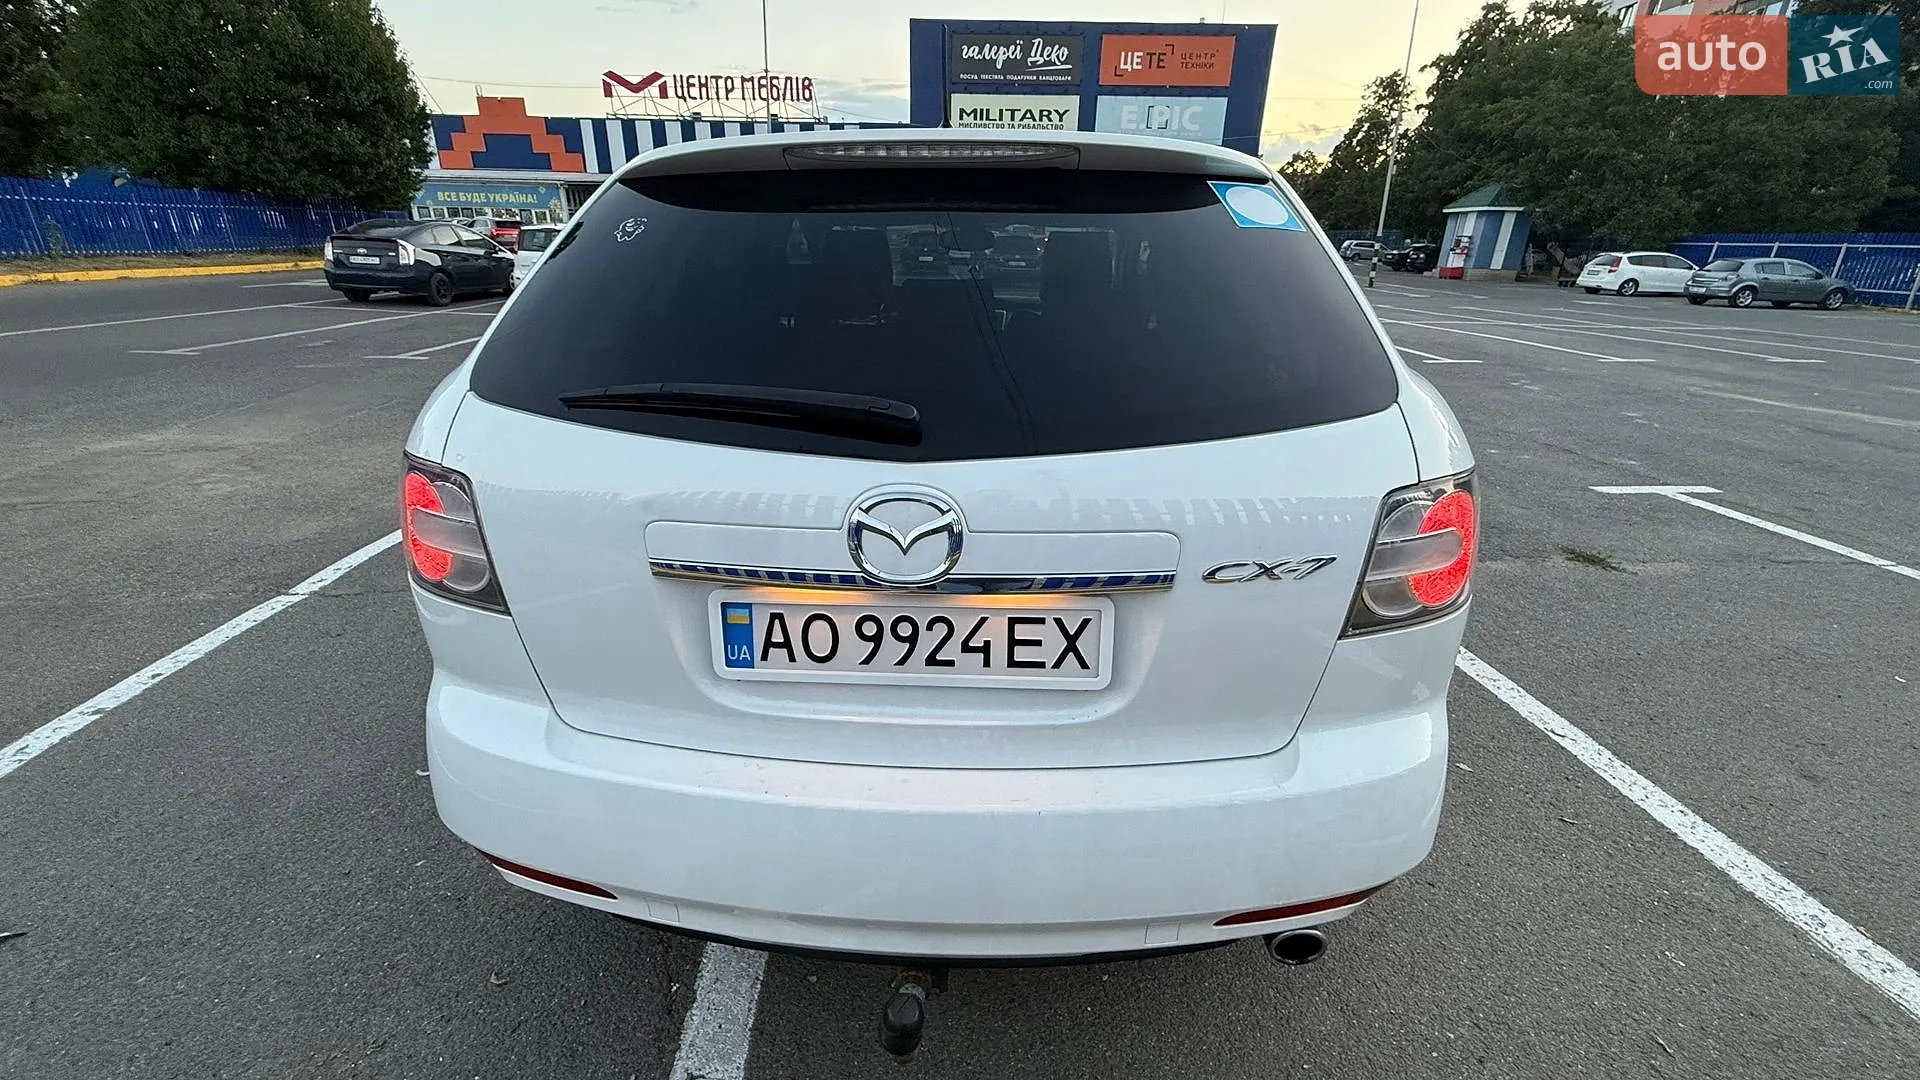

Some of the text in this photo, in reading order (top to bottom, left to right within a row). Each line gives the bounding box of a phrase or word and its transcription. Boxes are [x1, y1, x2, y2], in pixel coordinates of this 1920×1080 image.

[1180, 53, 1216, 61] ЦЕНТР
[1180, 61, 1215, 70] ТЕХНІКИ
[672, 74, 735, 101] ЦЕНТР
[741, 75, 814, 102] МЕБЛІВ
[959, 107, 1070, 123] MILITARY
[958, 122, 1005, 130] МИСЛИВСТВО
[1017, 123, 1065, 131] РИБАЛЬСТВО
[437, 190, 538, 204] ВСЕ БУДЕ УКРАЇНА!
[1202, 554, 1338, 585] CX-7
[759, 611, 1094, 670] AO 9924 EX
[727, 644, 752, 662] UA
